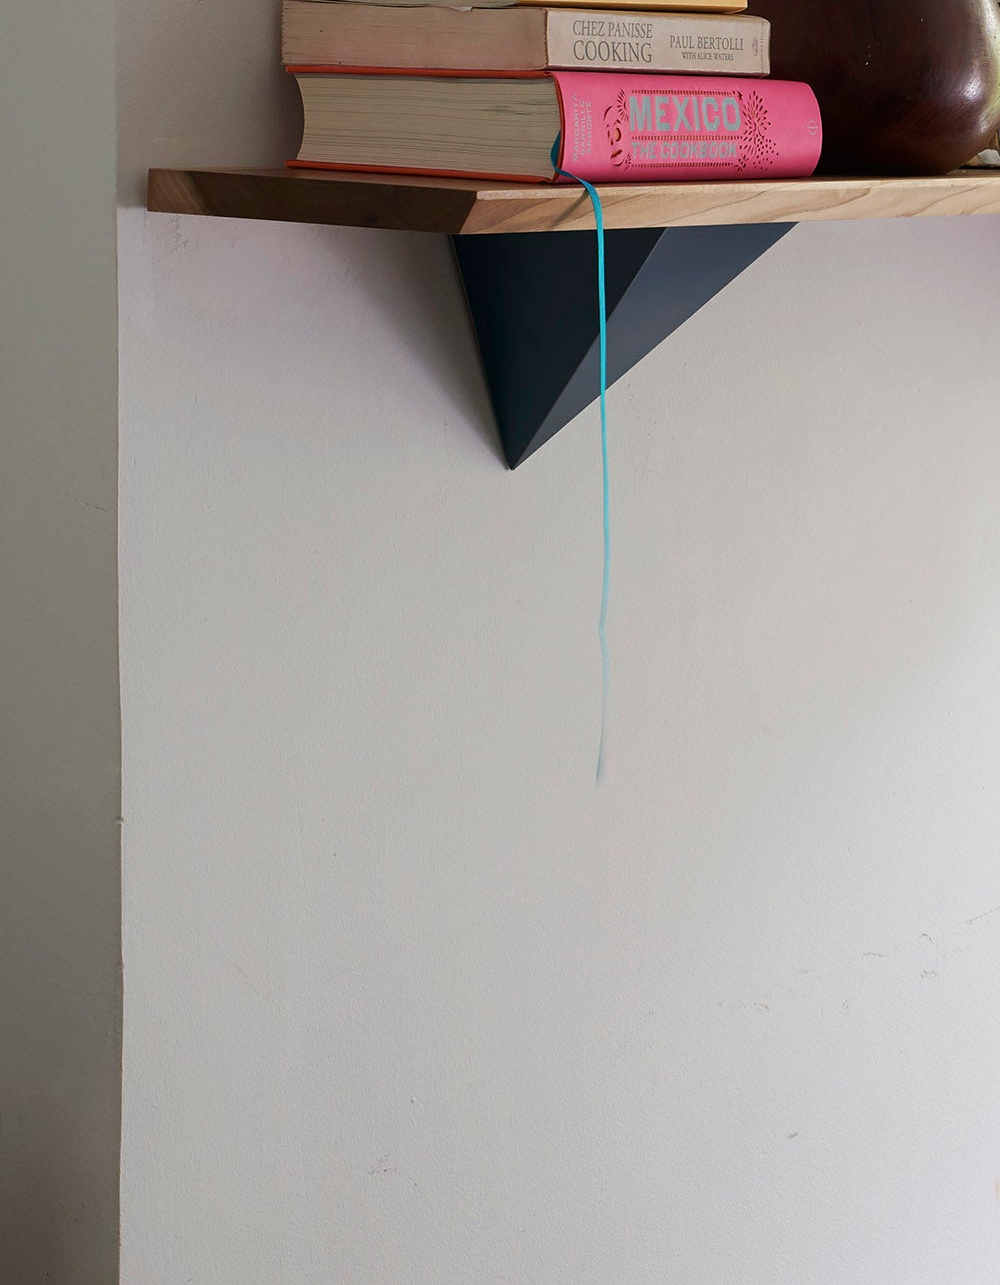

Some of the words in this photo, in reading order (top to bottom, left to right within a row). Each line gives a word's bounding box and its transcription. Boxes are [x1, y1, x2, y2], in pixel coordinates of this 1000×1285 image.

[572, 20, 604, 37] CHEZ
[607, 21, 653, 39] PANISSE
[573, 40, 653, 63] COOKING
[670, 35, 694, 49] PAUL
[697, 36, 744, 51] BERTOLLI
[681, 51, 696, 60] WITH
[696, 52, 713, 61] ALICE
[713, 52, 734, 61] WATERS
[629, 95, 741, 132] MEXICO
[631, 142, 657, 159] THE
[661, 141, 738, 159] COOKBOOK
